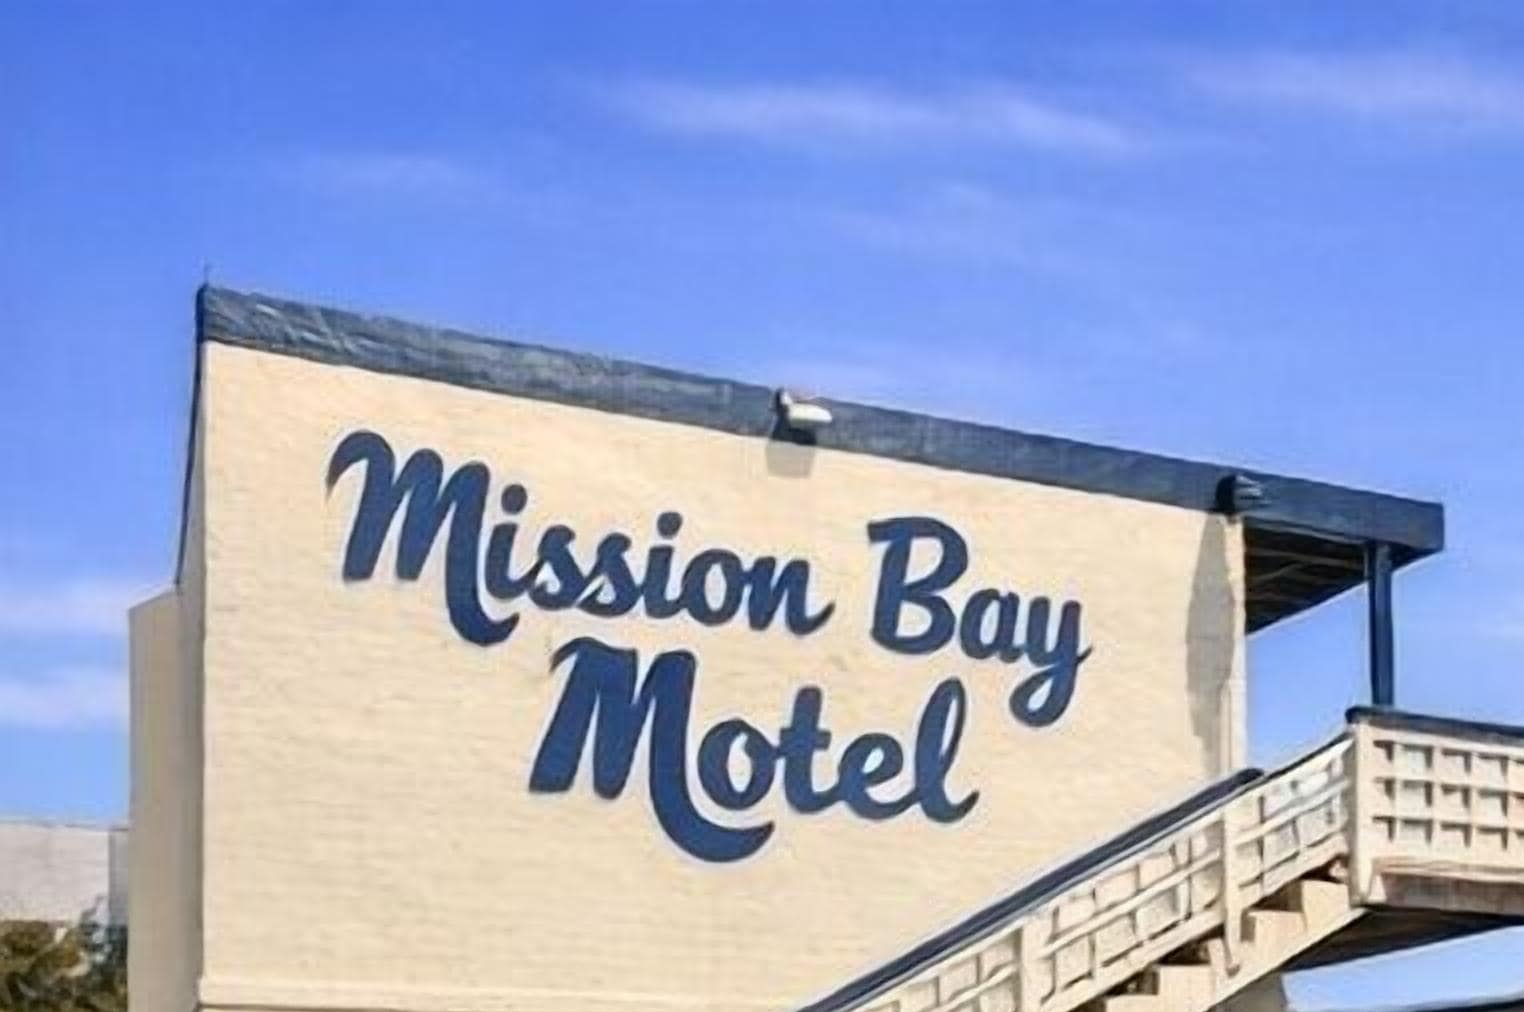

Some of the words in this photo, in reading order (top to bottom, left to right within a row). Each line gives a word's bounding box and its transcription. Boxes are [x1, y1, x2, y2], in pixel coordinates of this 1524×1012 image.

[326, 430, 835, 647] Mission
[868, 516, 1092, 728] Bay
[528, 636, 981, 863] Motel
